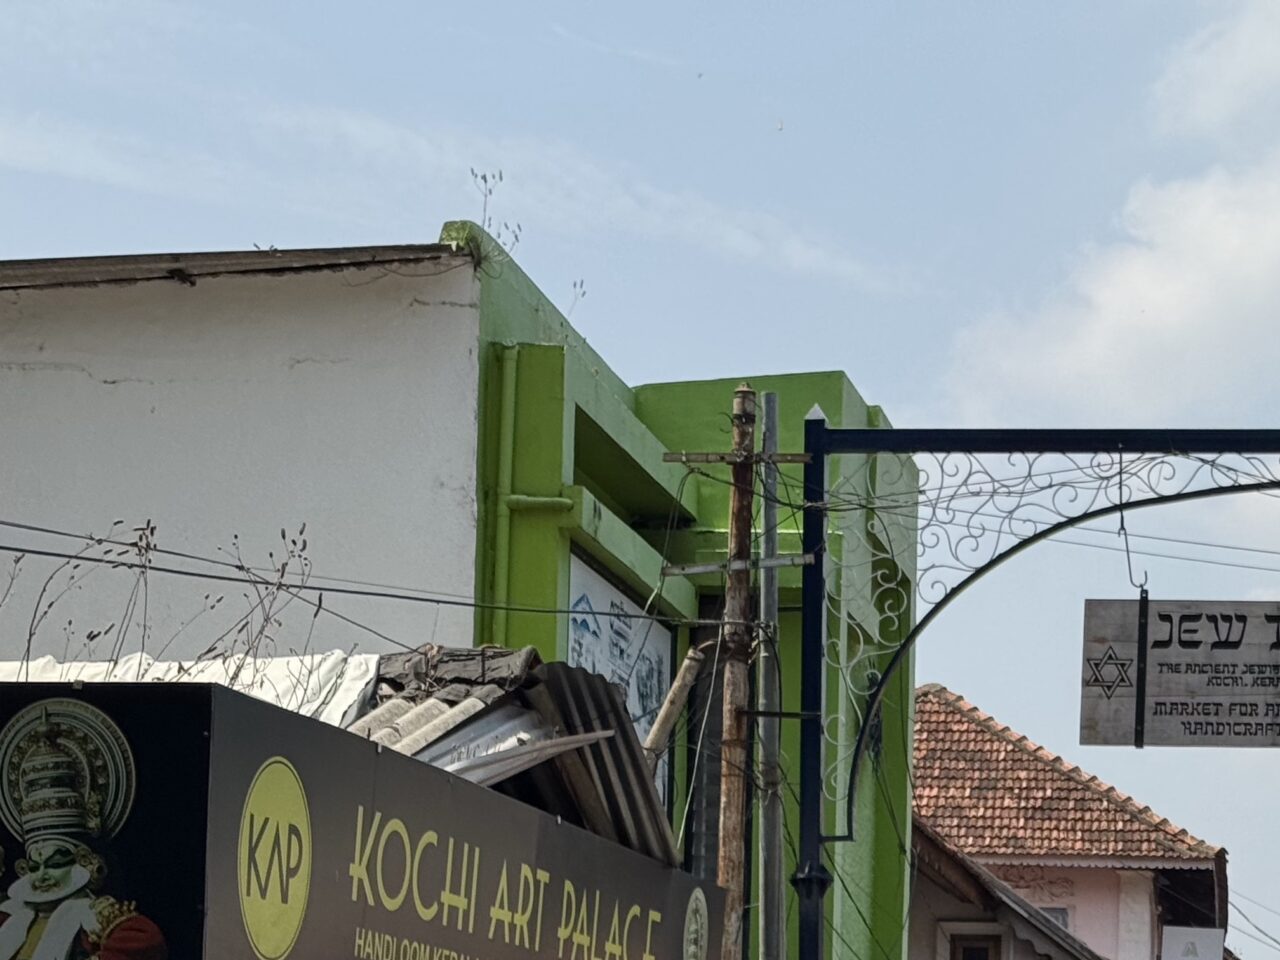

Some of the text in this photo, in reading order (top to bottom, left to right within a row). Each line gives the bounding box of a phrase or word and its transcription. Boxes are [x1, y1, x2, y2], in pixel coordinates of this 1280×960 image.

[1151, 612, 1247, 651] JEW
[1157, 663, 1182, 674] THE
[1184, 663, 1238, 675] ANCIENT
[1153, 702, 1223, 717] MARKET
[1228, 702, 1259, 717] FOR
[246, 812, 304, 905] KAP
[349, 805, 481, 934] KOCHI
[487, 858, 550, 952] ART
